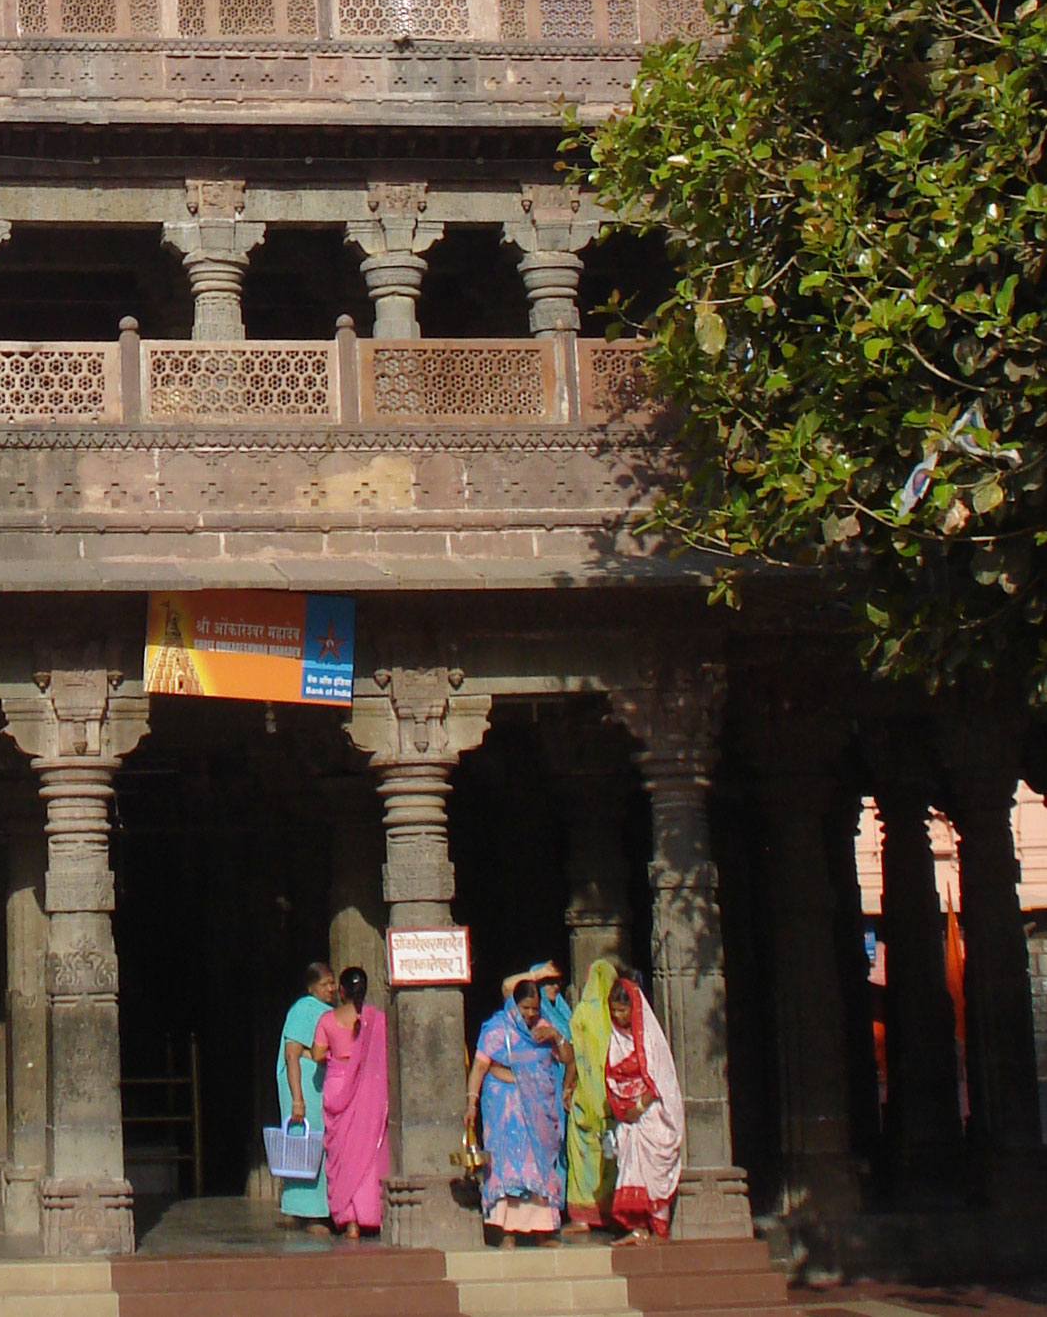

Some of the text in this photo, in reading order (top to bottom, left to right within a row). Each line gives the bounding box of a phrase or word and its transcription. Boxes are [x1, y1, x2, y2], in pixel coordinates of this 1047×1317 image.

[267, 621, 301, 642] महादेव
[305, 685, 351, 697] Bank of India
